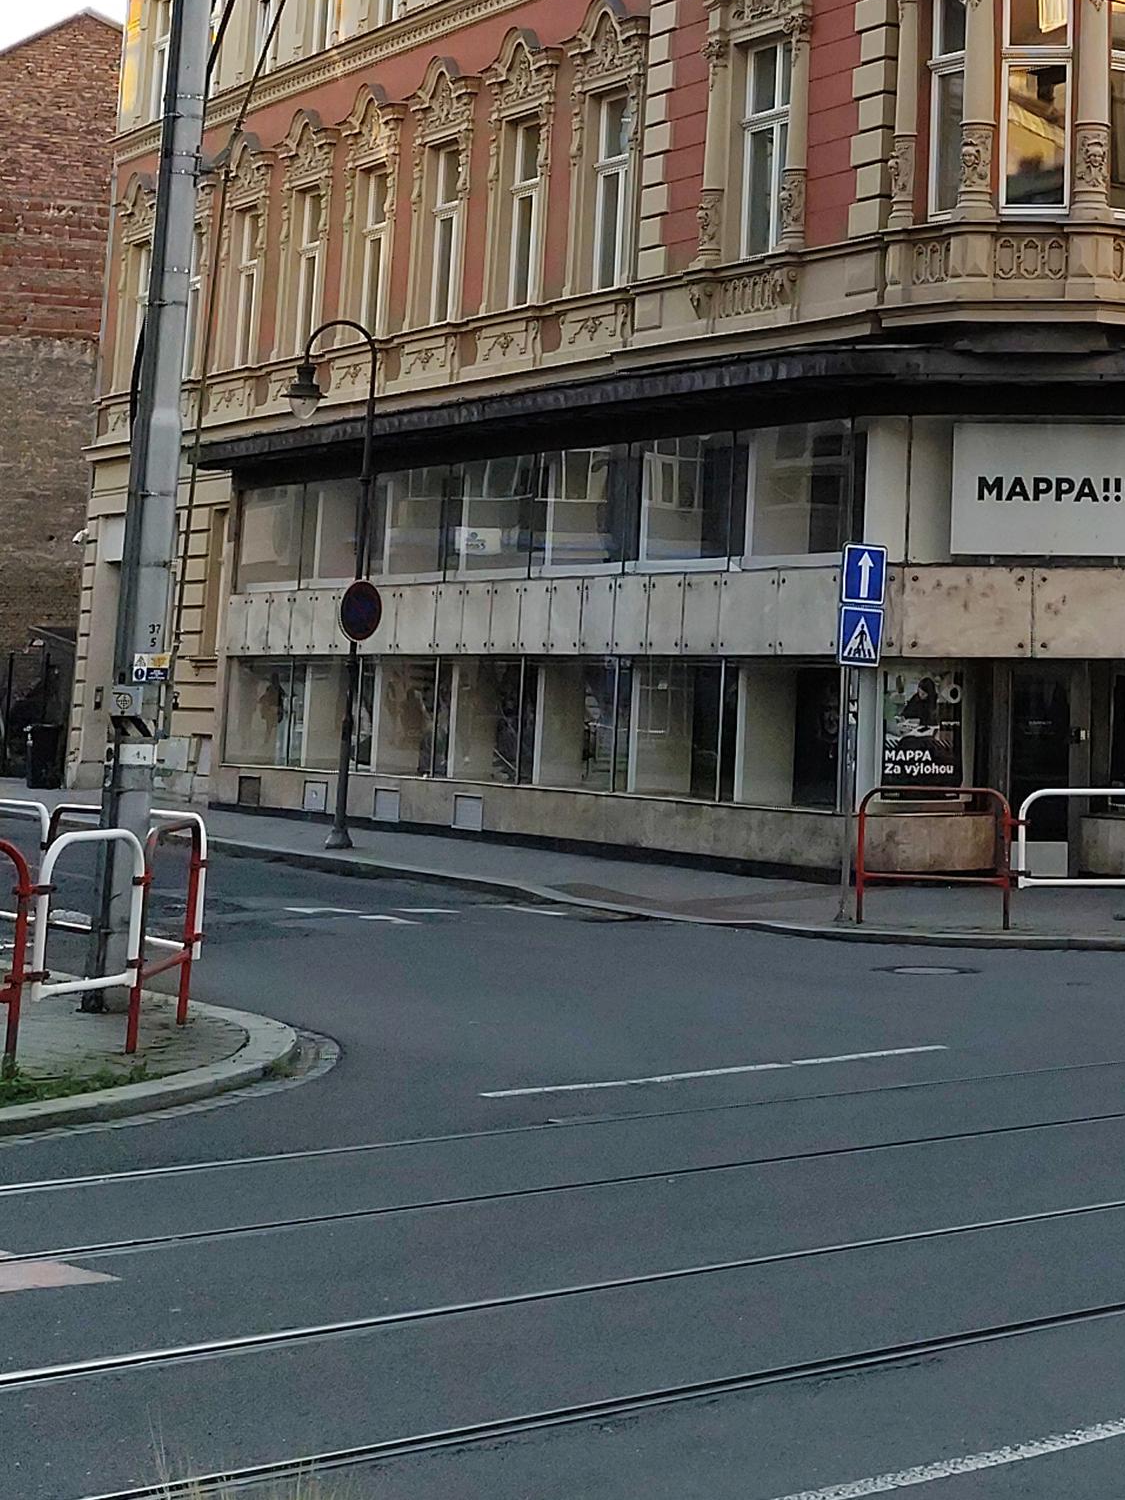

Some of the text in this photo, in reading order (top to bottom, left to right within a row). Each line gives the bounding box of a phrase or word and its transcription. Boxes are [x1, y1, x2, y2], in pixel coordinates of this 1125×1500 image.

[885, 750, 932, 762] MAPPA
[884, 762, 954, 777] Za výlohou
